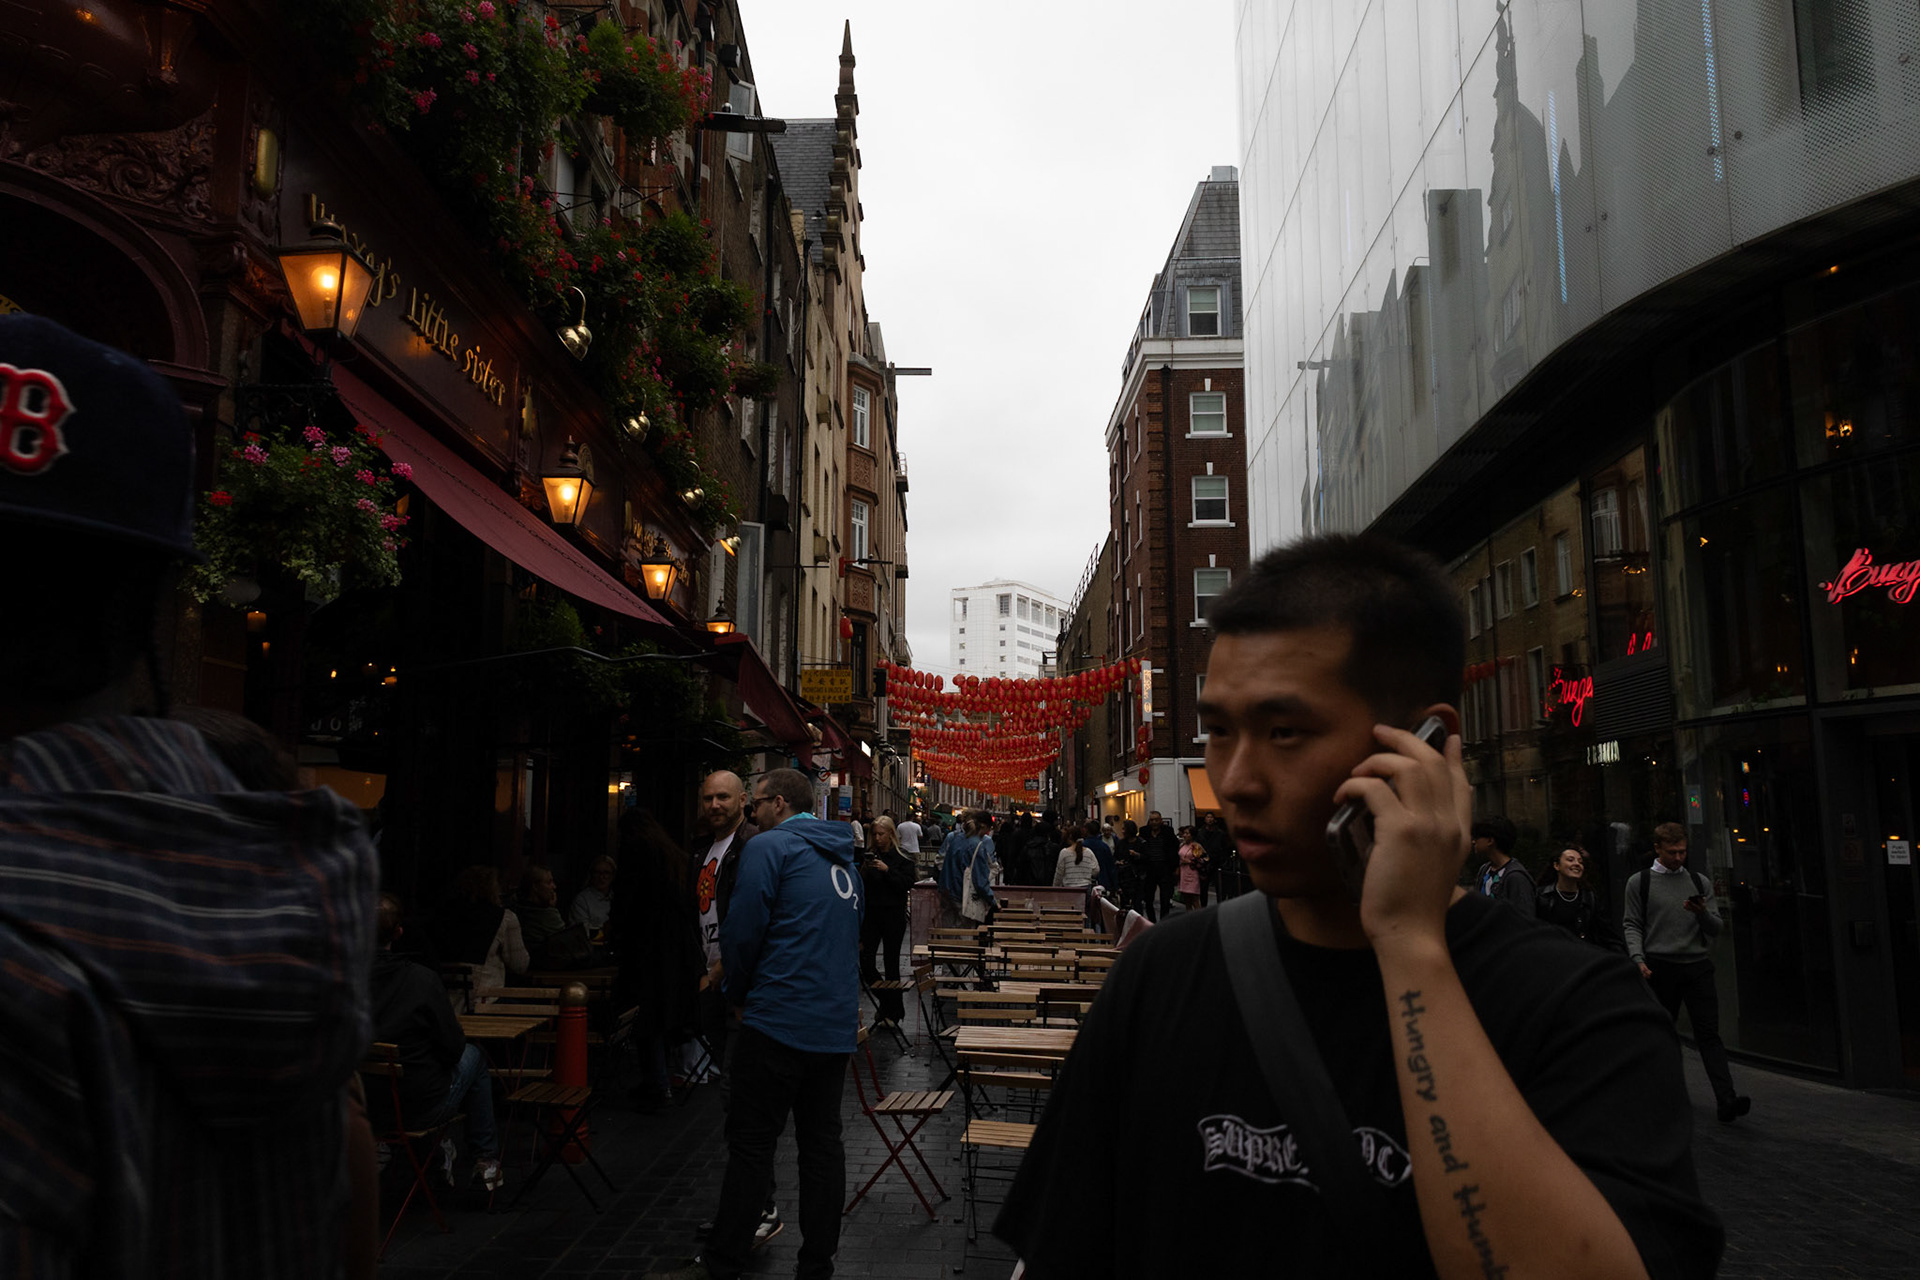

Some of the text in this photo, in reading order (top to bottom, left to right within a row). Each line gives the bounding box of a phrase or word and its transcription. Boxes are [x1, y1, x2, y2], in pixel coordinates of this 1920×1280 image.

[0, 362, 77, 476] B
[1400, 989, 1437, 1102] Hungry
[1430, 1114, 1470, 1174] and
